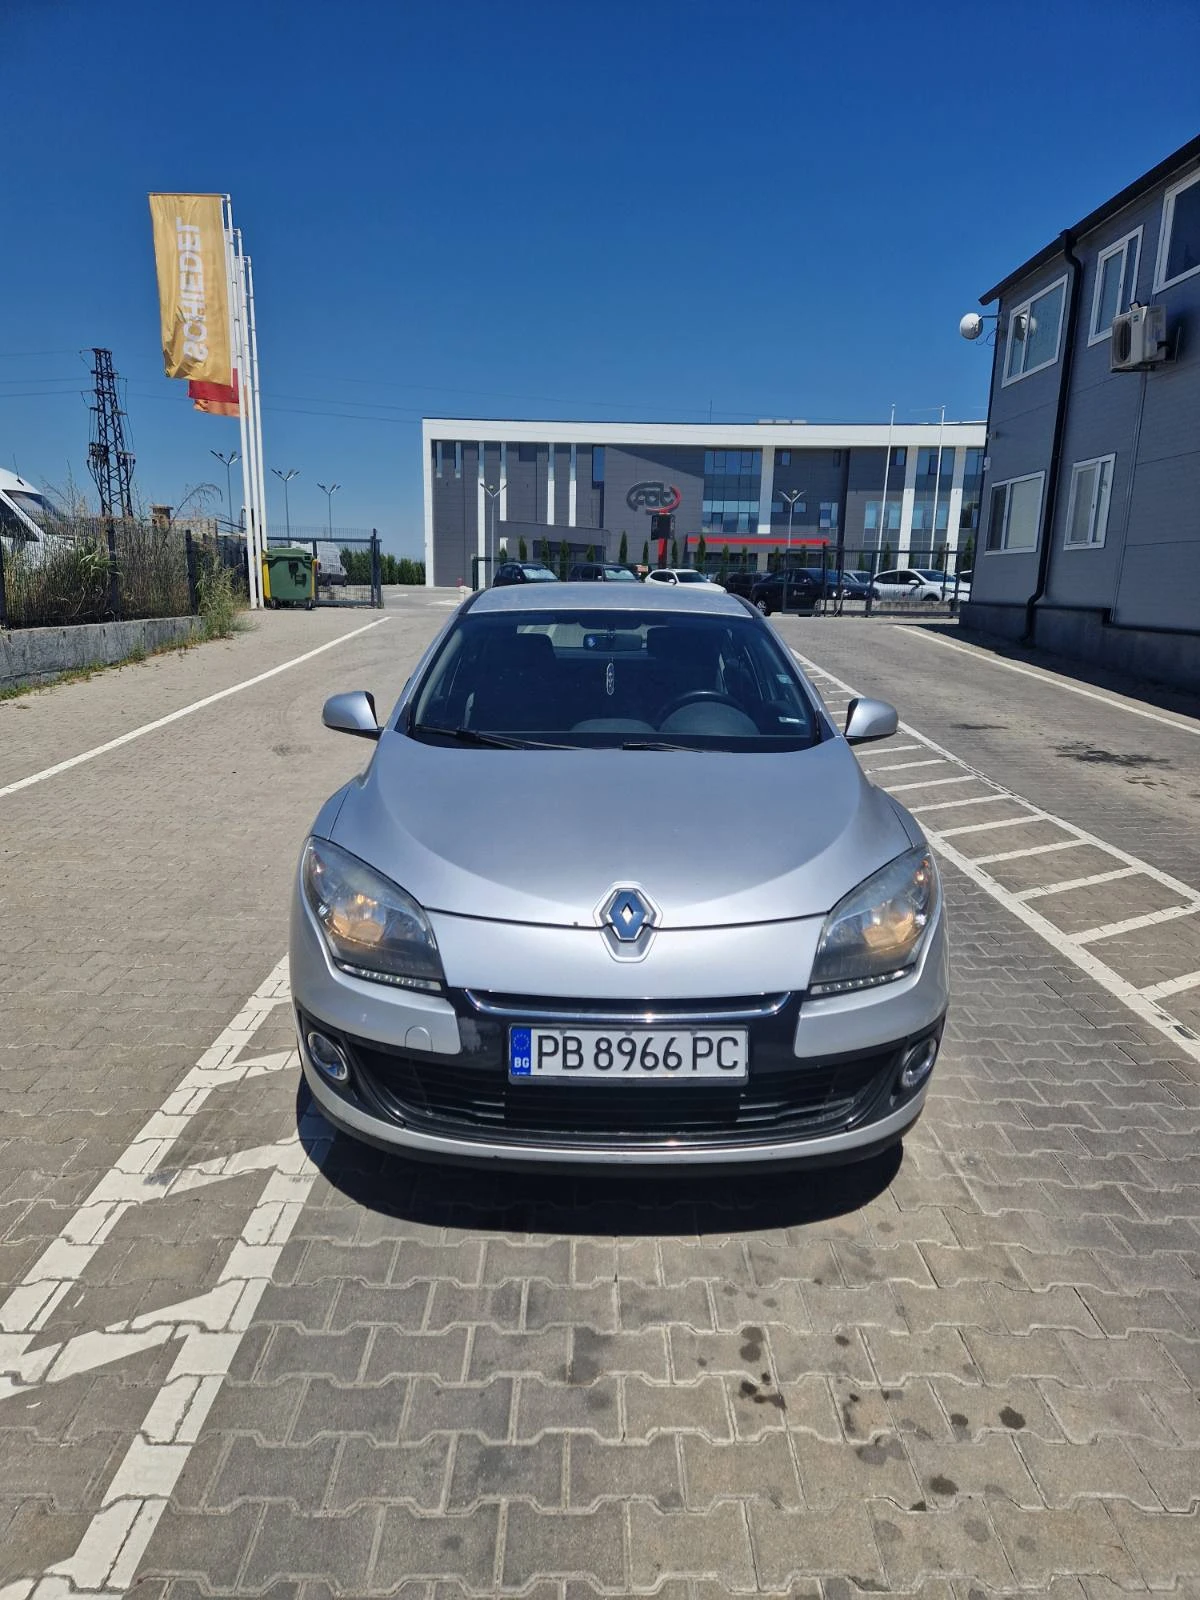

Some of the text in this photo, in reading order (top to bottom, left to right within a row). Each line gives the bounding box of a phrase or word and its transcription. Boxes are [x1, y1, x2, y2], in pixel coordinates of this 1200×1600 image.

[514, 1056, 530, 1068] BG
[537, 1035, 739, 1071] PB 8966 PC
